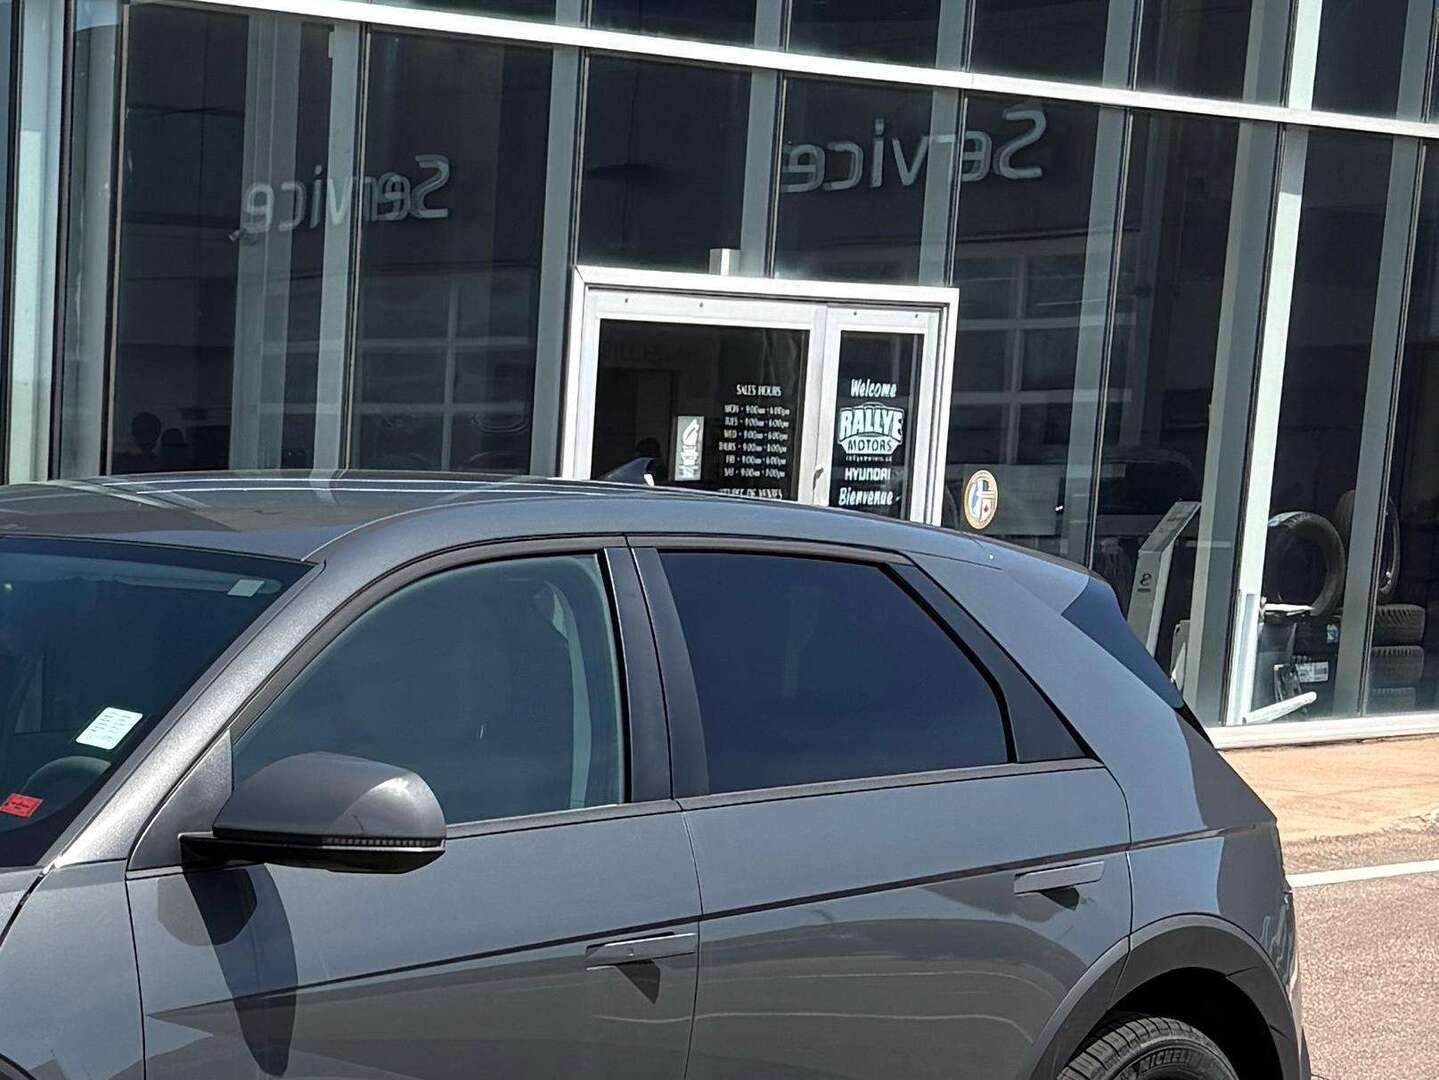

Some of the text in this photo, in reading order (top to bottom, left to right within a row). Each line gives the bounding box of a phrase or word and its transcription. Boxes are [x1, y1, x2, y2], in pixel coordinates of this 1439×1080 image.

[736, 384, 757, 396] SALES
[850, 378, 897, 398] Welcome
[839, 407, 904, 442] RALLYE
[847, 438, 893, 453] MOTORS
[844, 467, 892, 481] HYUNDAI
[838, 486, 894, 506] Bienvenue
